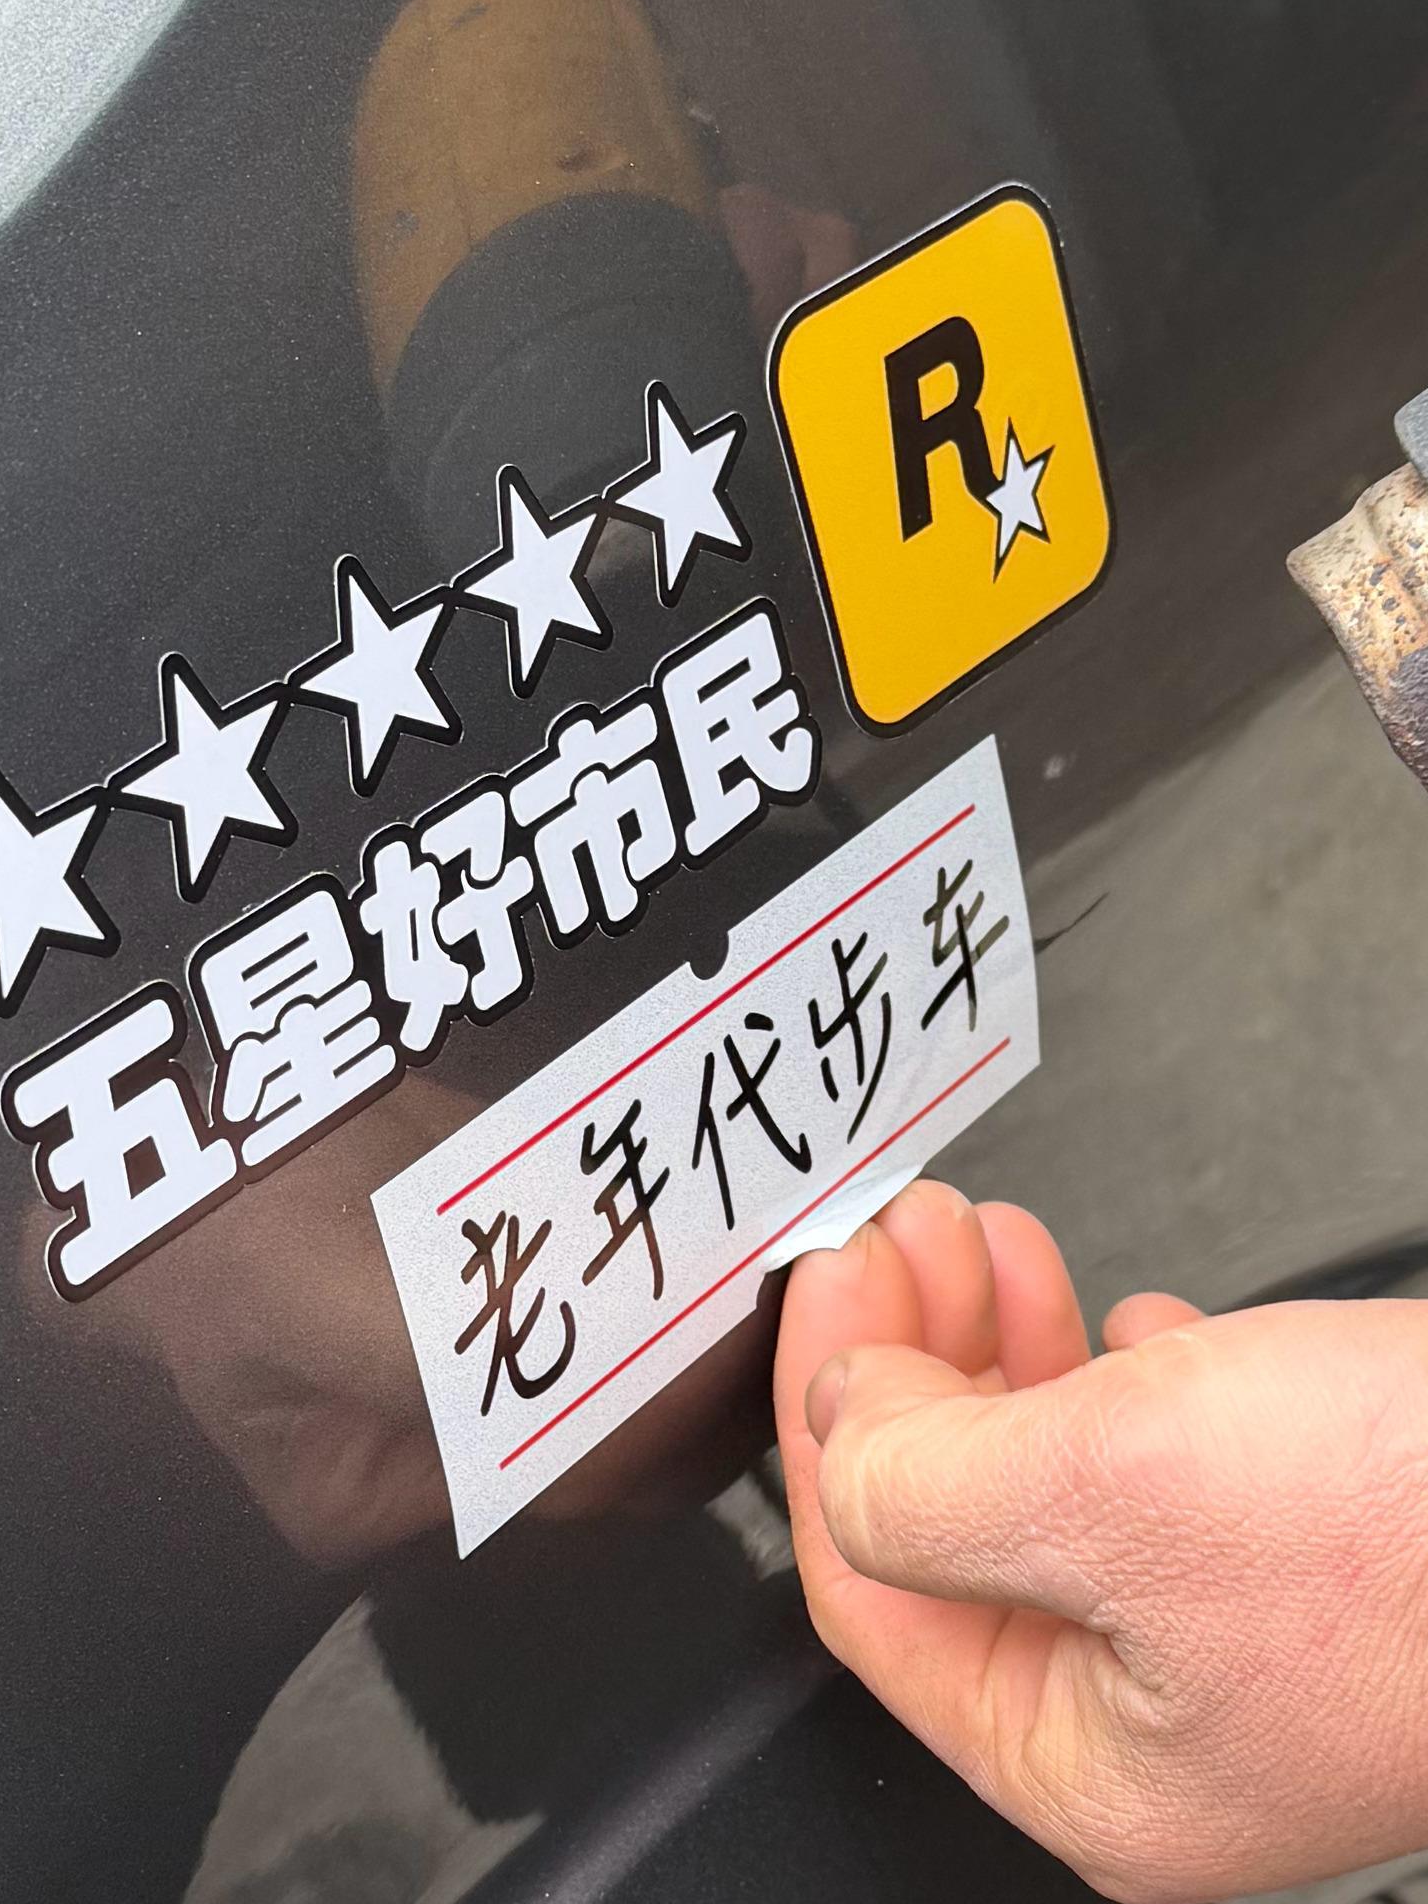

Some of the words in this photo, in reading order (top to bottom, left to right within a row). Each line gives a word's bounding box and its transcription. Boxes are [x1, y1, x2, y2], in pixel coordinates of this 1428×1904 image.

[884, 316, 1003, 543] R
[14, 610, 814, 1287] 五星好市民
[454, 858, 1010, 1416] 老年代步车
